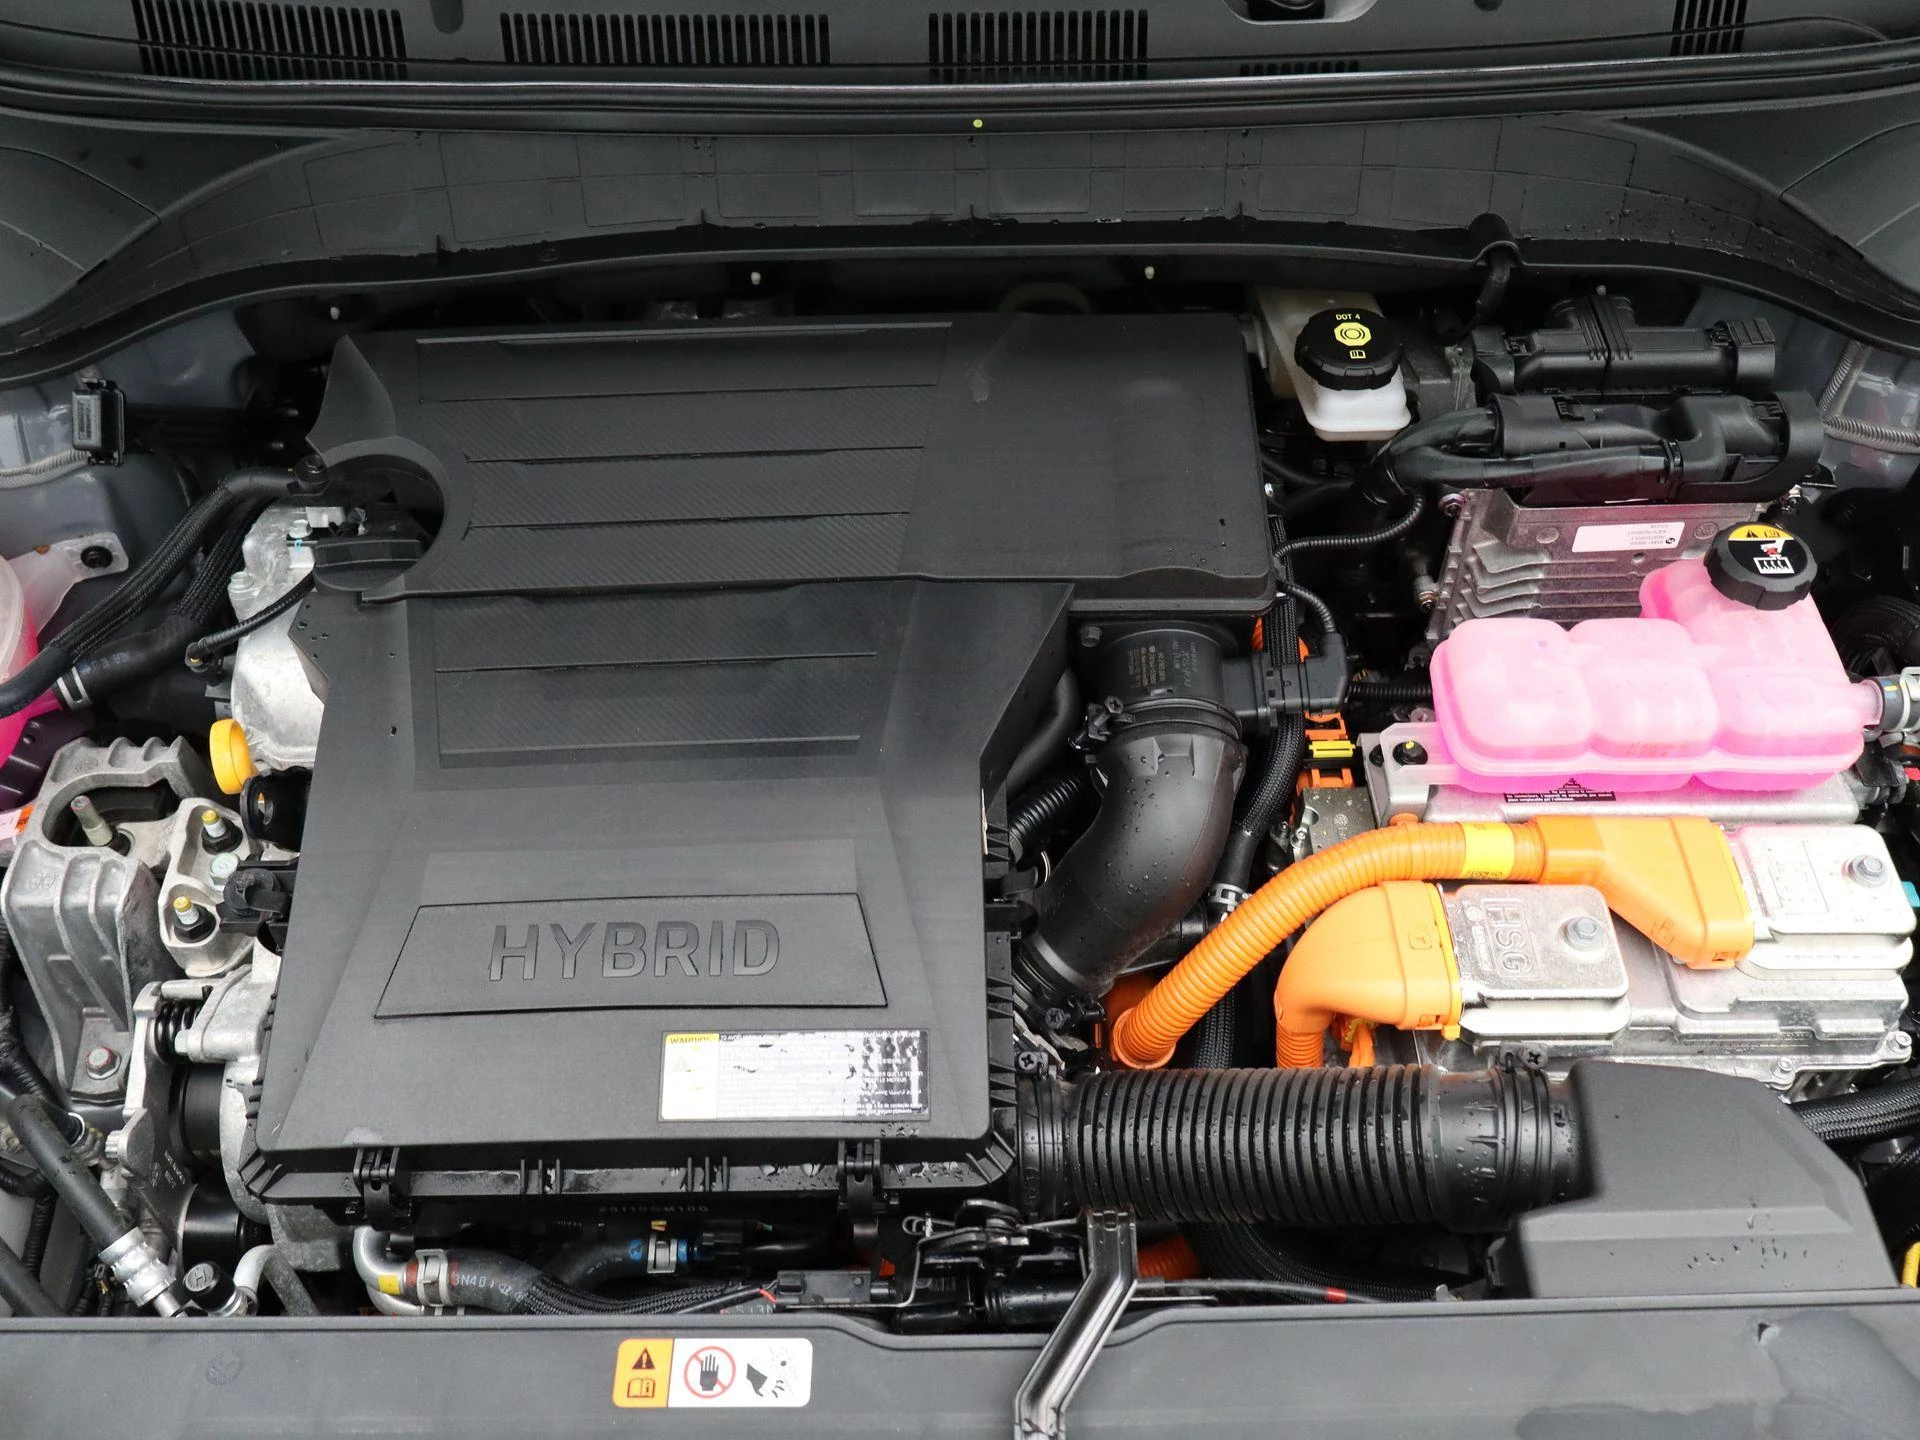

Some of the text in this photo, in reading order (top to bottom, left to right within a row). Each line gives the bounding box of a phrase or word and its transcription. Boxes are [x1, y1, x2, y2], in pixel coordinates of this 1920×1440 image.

[1336, 313, 1352, 321] DOT
[488, 919, 780, 982] HYBRID
[1486, 901, 1533, 974] HSG
